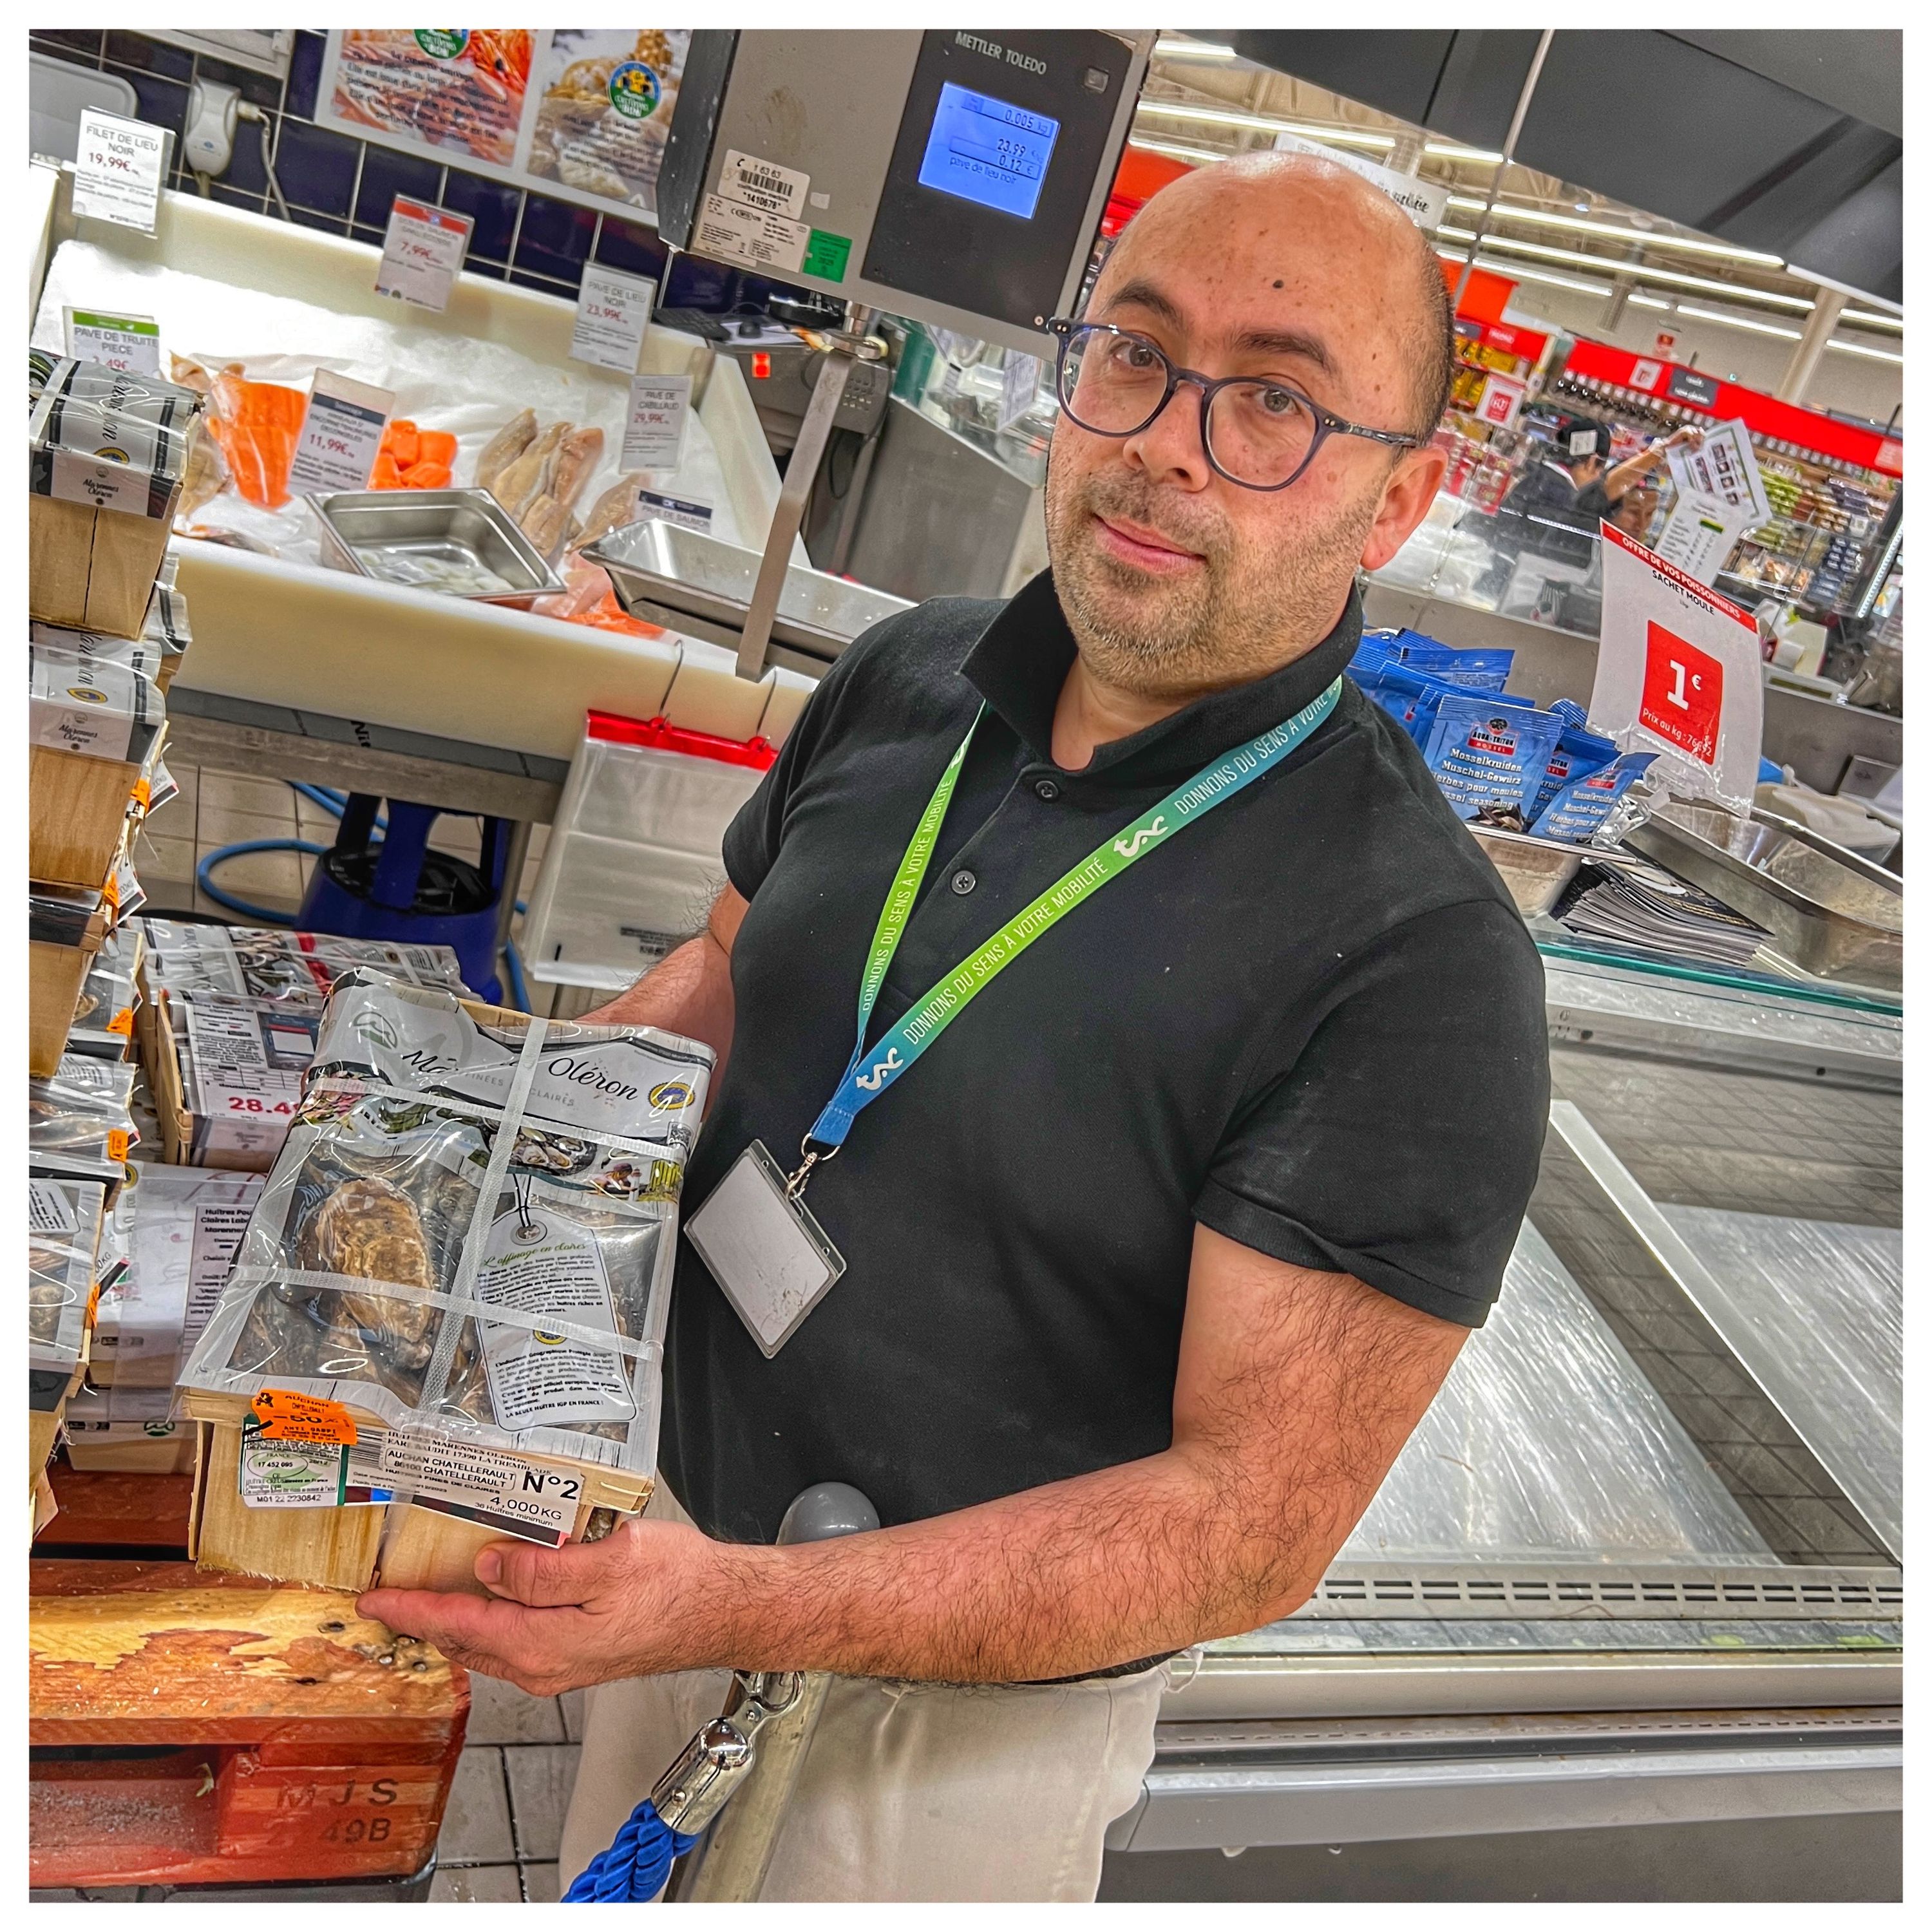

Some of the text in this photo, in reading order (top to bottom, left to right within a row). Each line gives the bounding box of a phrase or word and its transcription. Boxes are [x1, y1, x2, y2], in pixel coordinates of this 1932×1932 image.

[955, 32, 1047, 75] METTLER TOLEDO
[1005, 109, 1034, 128] 0.005
[86, 126, 158, 151] FILET DE LIEU
[997, 138, 1026, 157] 23.99
[108, 143, 135, 157] NOIR
[999, 155, 1022, 171] 0.12
[972, 163, 983, 173] de
[985, 166, 999, 179] lieu
[1000, 173, 1018, 184] noir
[588, 281, 609, 294] PAVE
[611, 287, 624, 298] DE
[604, 295, 627, 308] NOIR
[74, 327, 159, 347] PAVE DE TRUITE
[101, 342, 133, 355] PIECE
[665, 392, 676, 400] DE
[1622, 536, 1650, 560] OFFRE
[1650, 555, 1662, 569] DE
[1662, 562, 1681, 580] VOS
[1681, 574, 1741, 619] POISSONNIERS
[1653, 569, 1685, 596] SACHET
[1686, 592, 1715, 616] MOULE
[1667, 659, 1702, 711] 1 €
[1642, 707, 1659, 725] Prix
[1660, 719, 1671, 732] au
[1671, 724, 1682, 740] kg
[1173, 764, 1237, 815] DONNONS
[1233, 749, 1258, 773] DU
[1253, 724, 1289, 759] SENS
[1450, 748, 1522, 772] Mosselkruiden
[1466, 783, 1524, 798] pour moules
[1468, 797, 1513, 810] seasoning
[862, 779, 952, 1011] DONNONS DU SENS À VOTRE MOBILITÉ
[903, 857, 1108, 1045] DONNONS DU SENS À VOTRE MOBILITÉ
[548, 1057, 639, 1102] Oléron
[554, 1242, 587, 1251] claires
[285, 1395, 329, 1408] AUCHAN
[432, 1439, 485, 1455] MARENNES
[453, 1450, 477, 1461] 17390
[388, 1450, 430, 1464] AUCHAN
[432, 1458, 516, 1481] CHATELLERAULT
[393, 1461, 421, 1471] 86100
[423, 1466, 507, 1488] CHATELLERAULT
[522, 1471, 580, 1501] N°2
[516, 1512, 553, 1527] minimum
